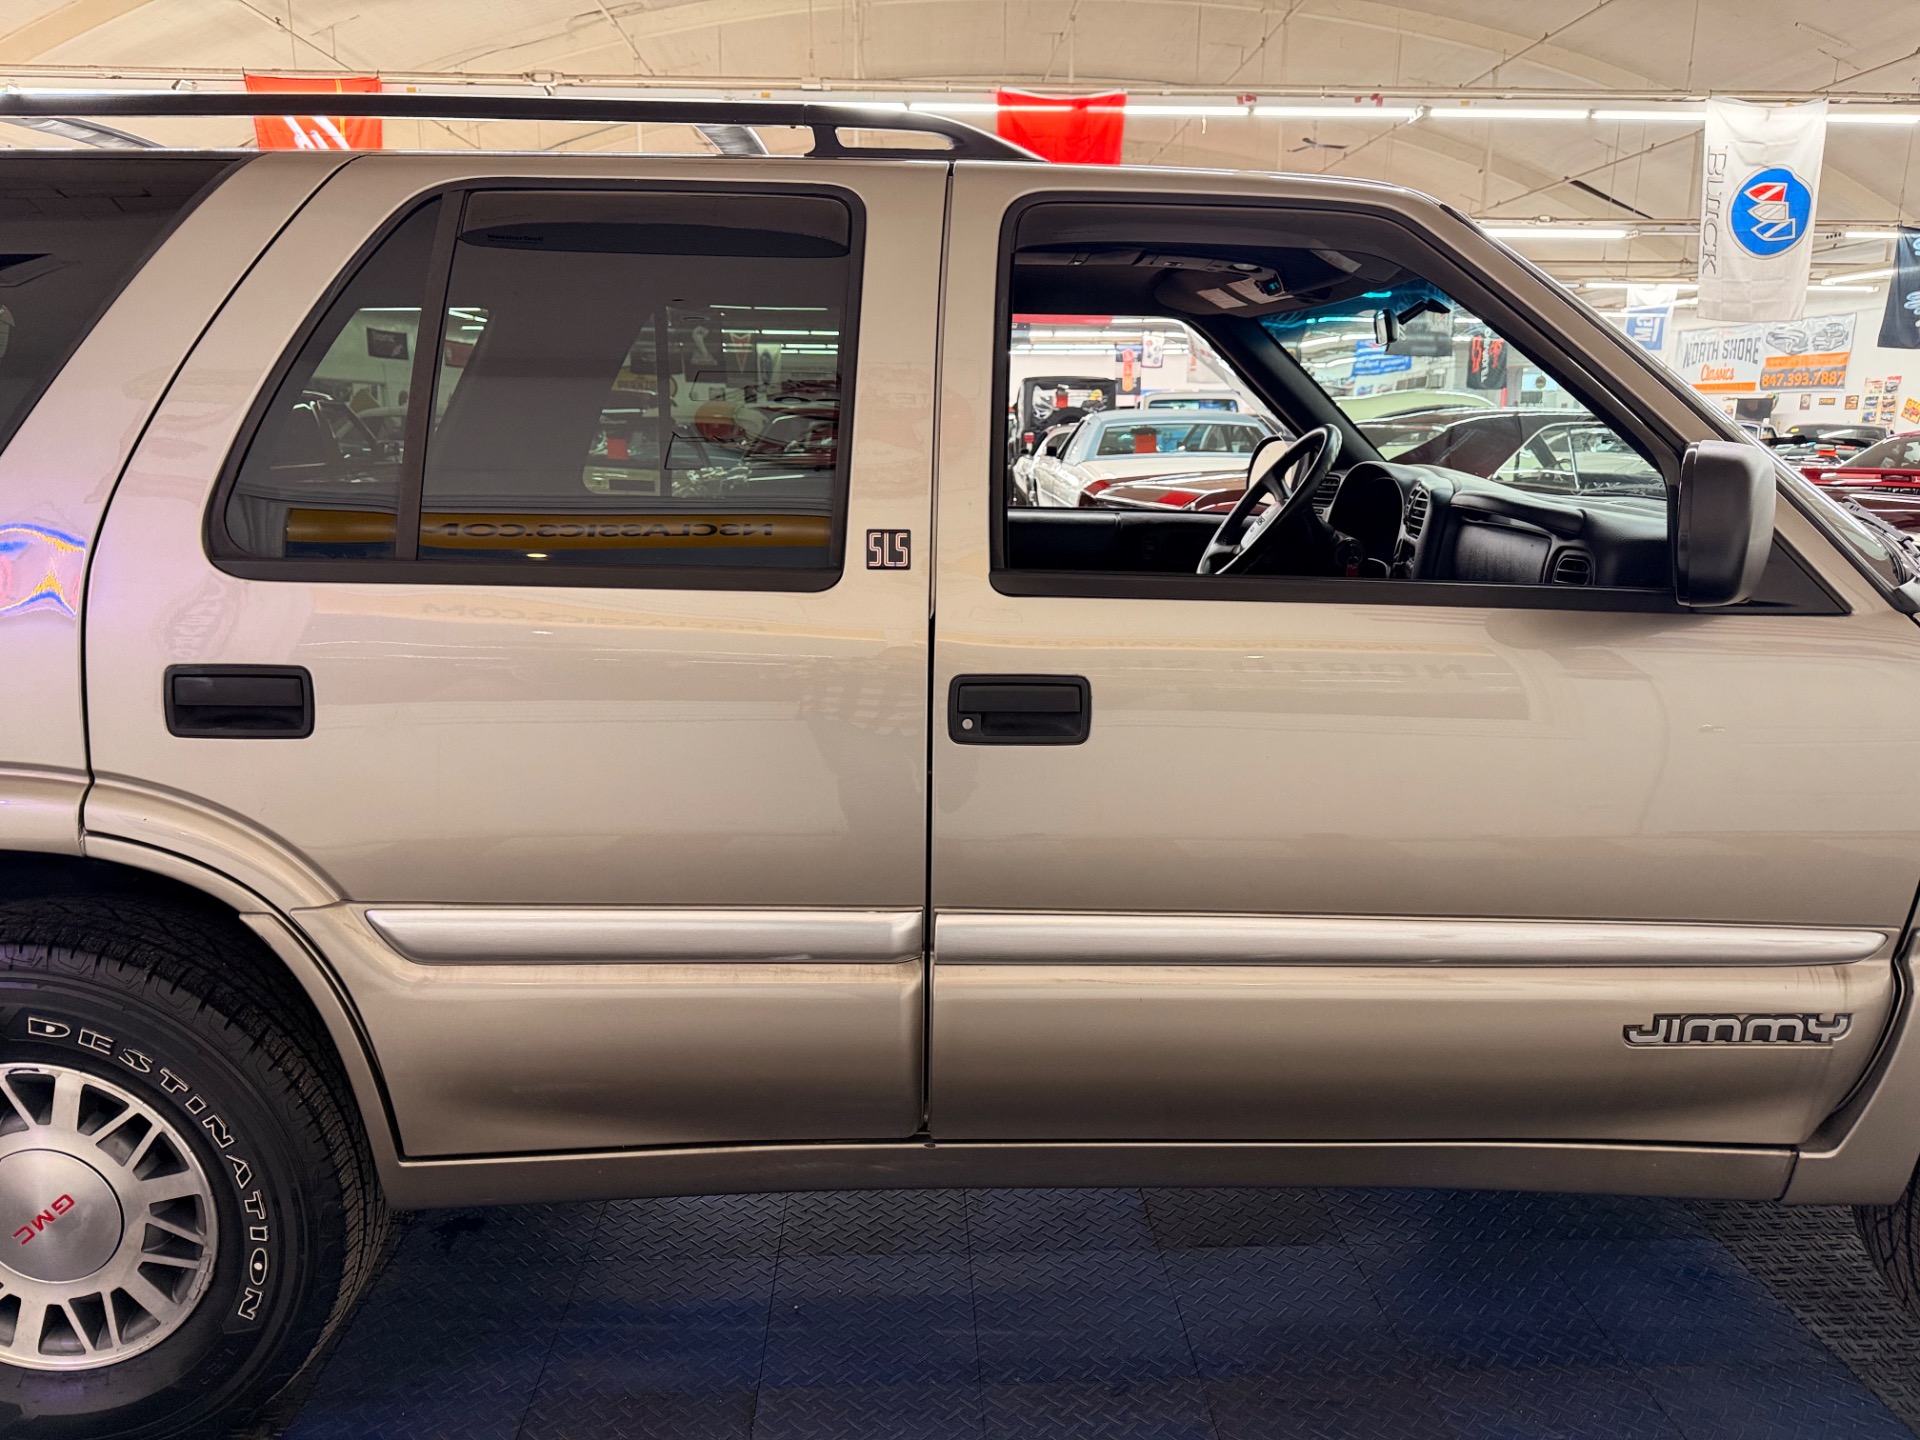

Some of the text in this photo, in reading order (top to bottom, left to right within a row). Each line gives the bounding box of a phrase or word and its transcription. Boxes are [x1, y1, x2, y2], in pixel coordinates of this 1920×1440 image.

[1702, 145, 1728, 275] BUICK
[1683, 339, 1720, 369] NORTH
[1722, 337, 1761, 365] SHORE
[1700, 363, 1735, 381] Classics
[1761, 370, 1846, 387] 847.393.7887
[869, 532, 908, 567] SLS
[28, 1016, 270, 1321] DESTINATION
[12, 1193, 75, 1246] GMC
